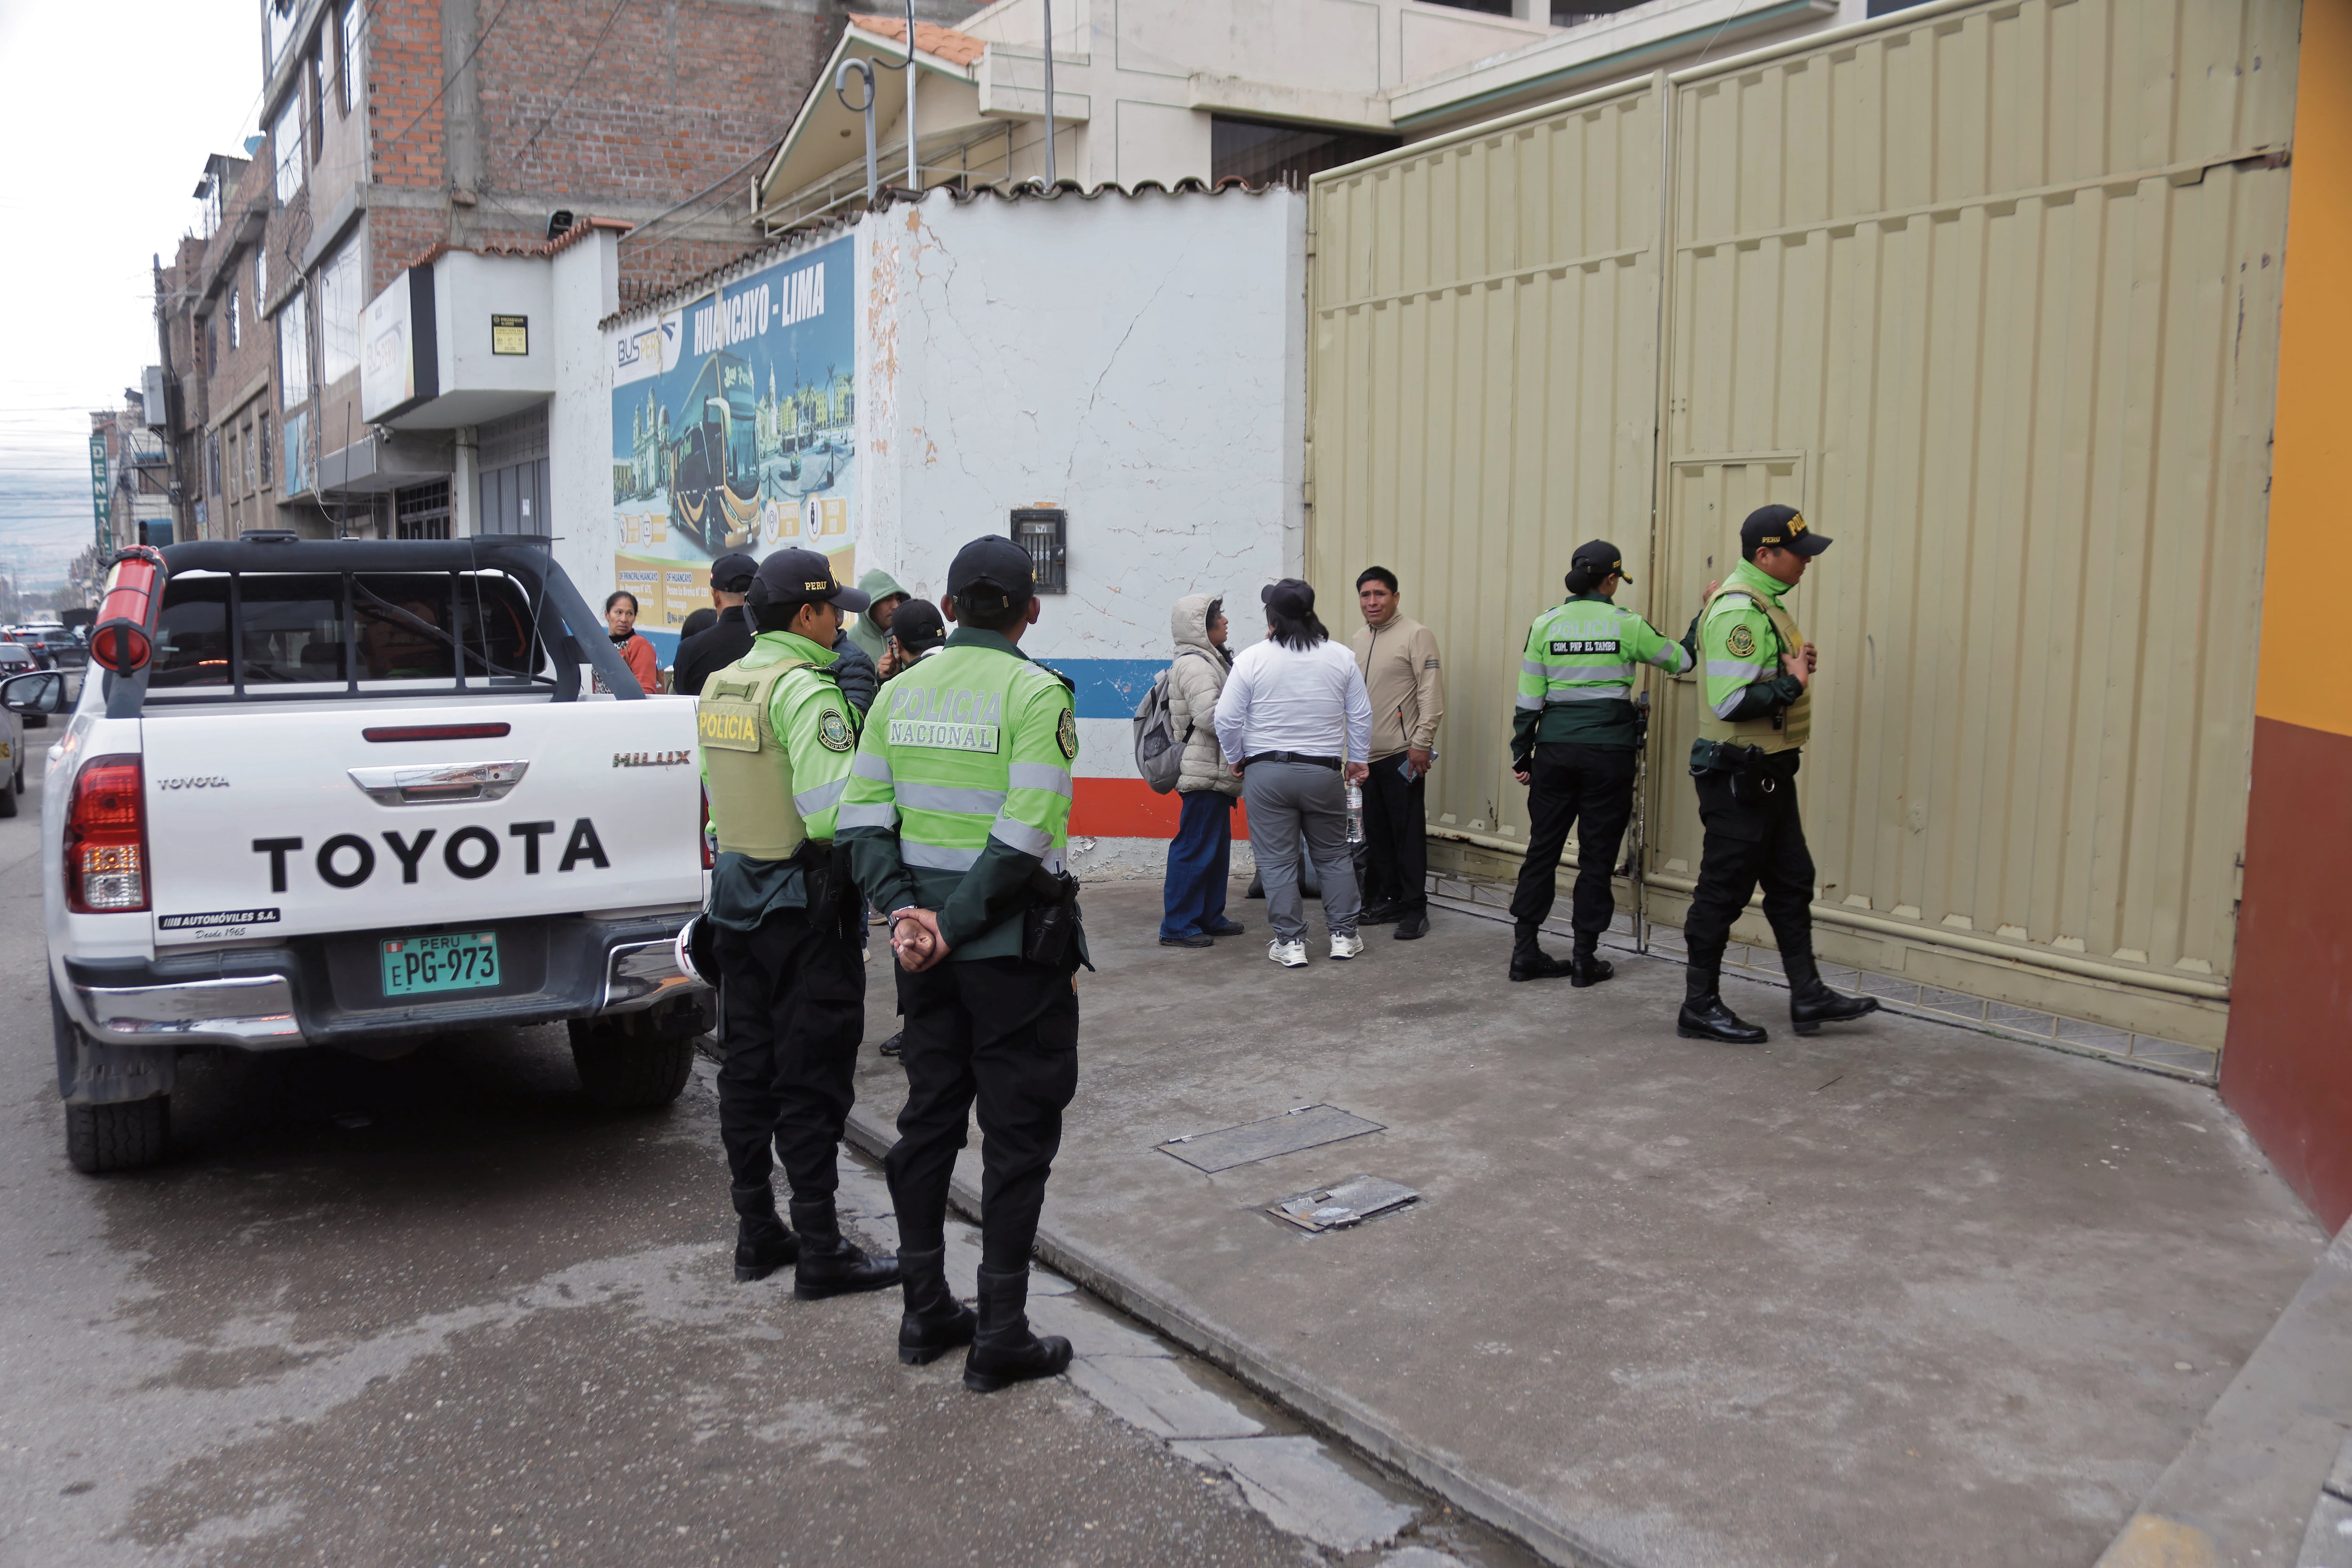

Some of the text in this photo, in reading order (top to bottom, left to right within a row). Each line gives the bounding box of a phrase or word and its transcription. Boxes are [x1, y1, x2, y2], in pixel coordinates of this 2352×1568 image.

[694, 283, 769, 357] HUANCAYO
[782, 262, 824, 327] LIMA
[672, 573, 692, 583] HUANCAYO
[804, 581, 827, 590] PERU
[1549, 620, 1621, 640] POLICIA
[1554, 641, 1616, 652] COM. PNP EL TAMBO
[699, 712, 755, 741] POLICIA
[890, 723, 991, 748] NACIONAL
[823, 737, 847, 749] REGPOL
[612, 749, 691, 767] HILUX
[157, 776, 230, 790] TOYOTA
[252, 817, 611, 894] TOYOTA
[182, 911, 277, 926] AUTOMÓVILES S.A.
[195, 927, 246, 939] Desde 1965
[420, 937, 460, 949] PERU
